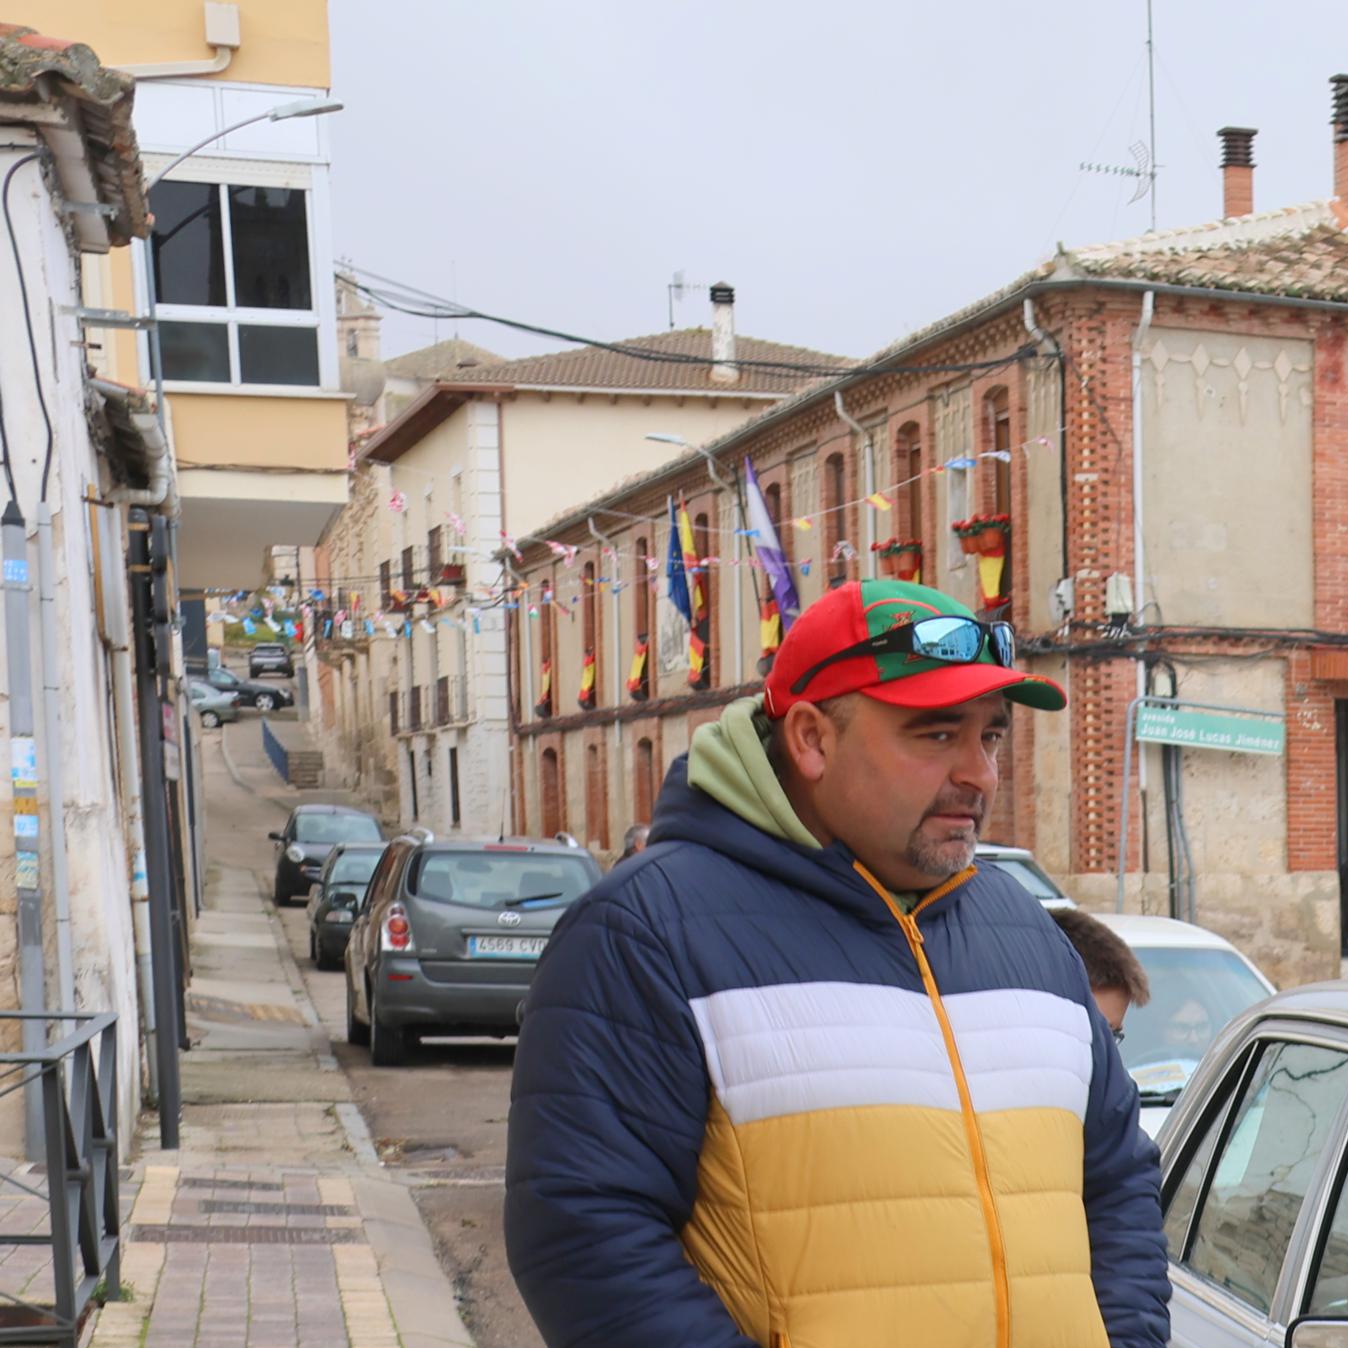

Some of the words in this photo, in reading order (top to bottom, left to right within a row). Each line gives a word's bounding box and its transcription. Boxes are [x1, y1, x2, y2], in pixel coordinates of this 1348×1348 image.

[1140, 723, 1168, 736] Juan
[1170, 725, 1196, 740] José
[1199, 729, 1231, 744] Lucas
[1235, 733, 1280, 750] Jiménez
